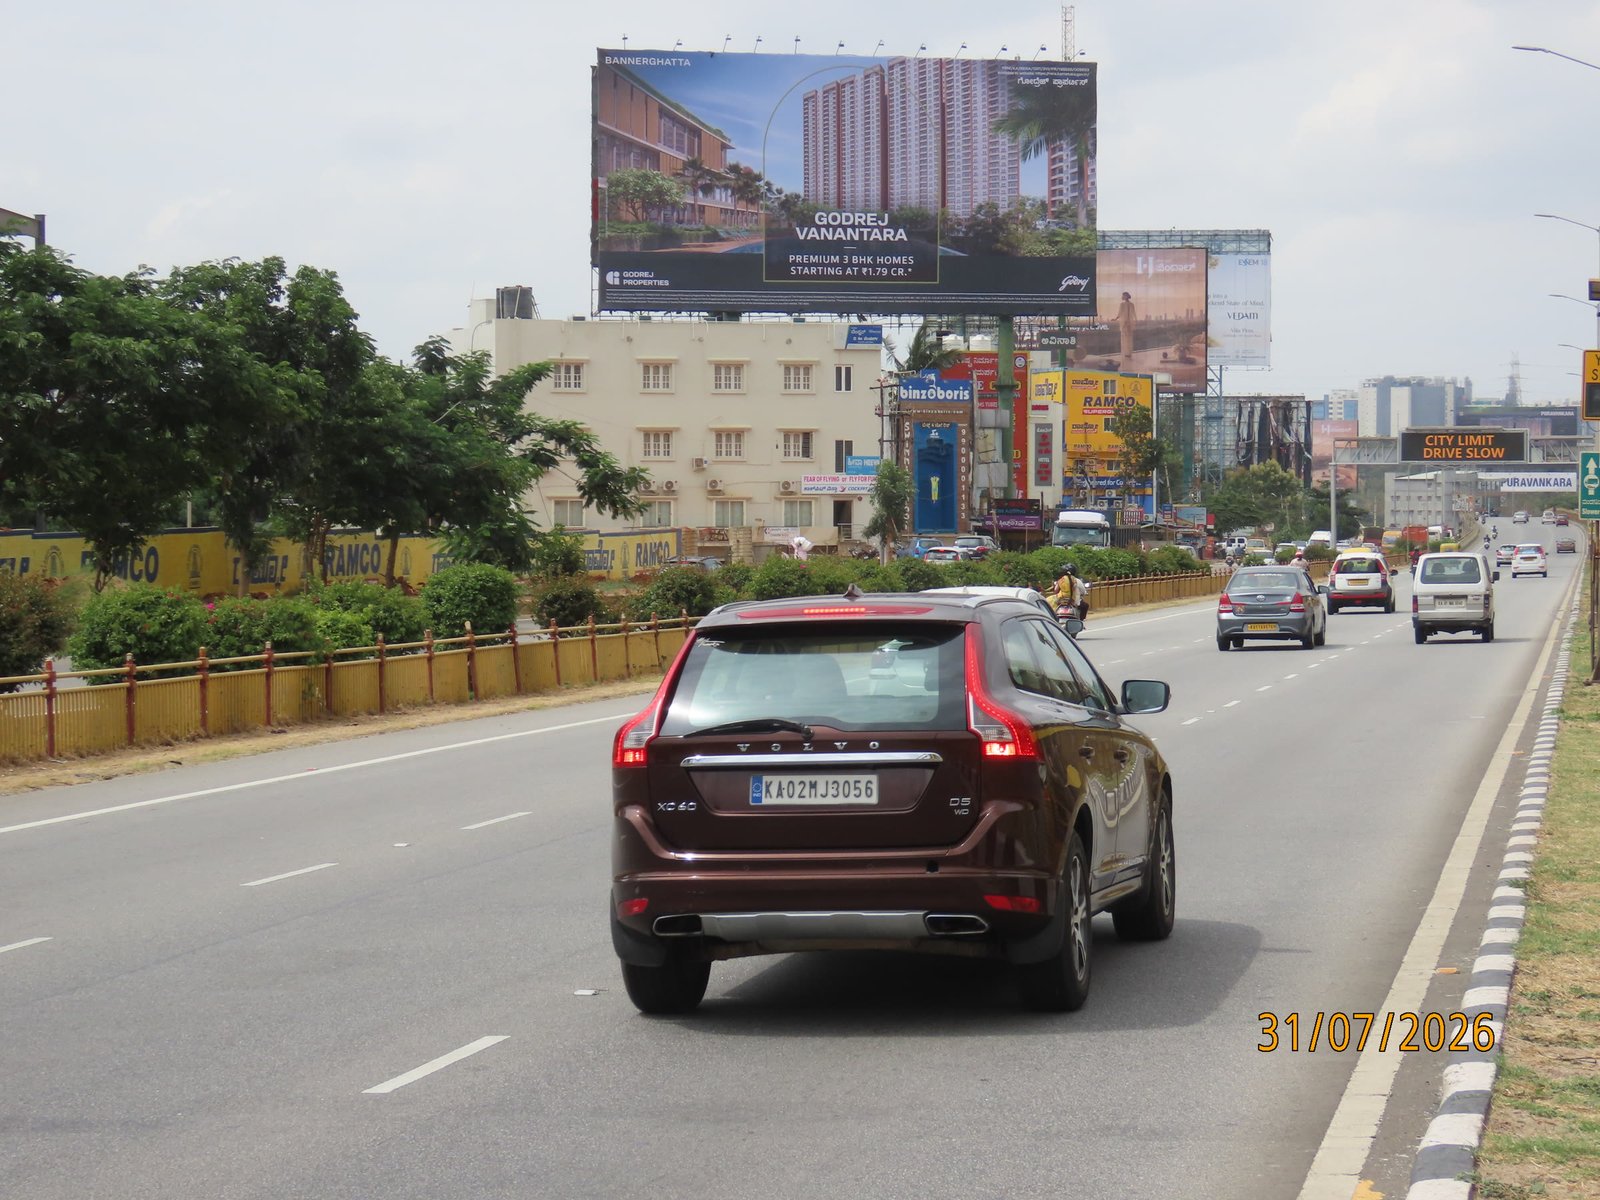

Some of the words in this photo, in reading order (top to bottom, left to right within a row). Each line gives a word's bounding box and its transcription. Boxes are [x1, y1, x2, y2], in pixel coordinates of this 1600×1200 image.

[605, 56, 691, 67] BANNERGHATTA
[814, 211, 889, 226] GODREJ
[795, 227, 908, 241] VANANTARA
[789, 254, 840, 264] PREMIUM
[843, 255, 849, 264] 3
[852, 255, 874, 264] BHK
[876, 256, 914, 265] HOMES
[790, 266, 843, 276] STARTING
[845, 267, 859, 276] AT
[861, 267, 888, 277] ₹1.79
[1059, 275, 1090, 291] Godrej
[900, 384, 970, 400] binzoboris
[1083, 396, 1136, 407] RAMCO
[1425, 434, 1454, 446] CITY
[1457, 434, 1495, 446] LIMIT
[1423, 447, 1462, 459] DRIVE
[1466, 447, 1505, 459] SLOW
[1501, 477, 1573, 488] PURAVANKARA
[324, 543, 381, 577] RAMCO
[636, 541, 670, 567] RAMCO
[737, 741, 879, 752] VOLVO
[763, 780, 874, 800] KA02MJ3056
[949, 797, 972, 807] D5
